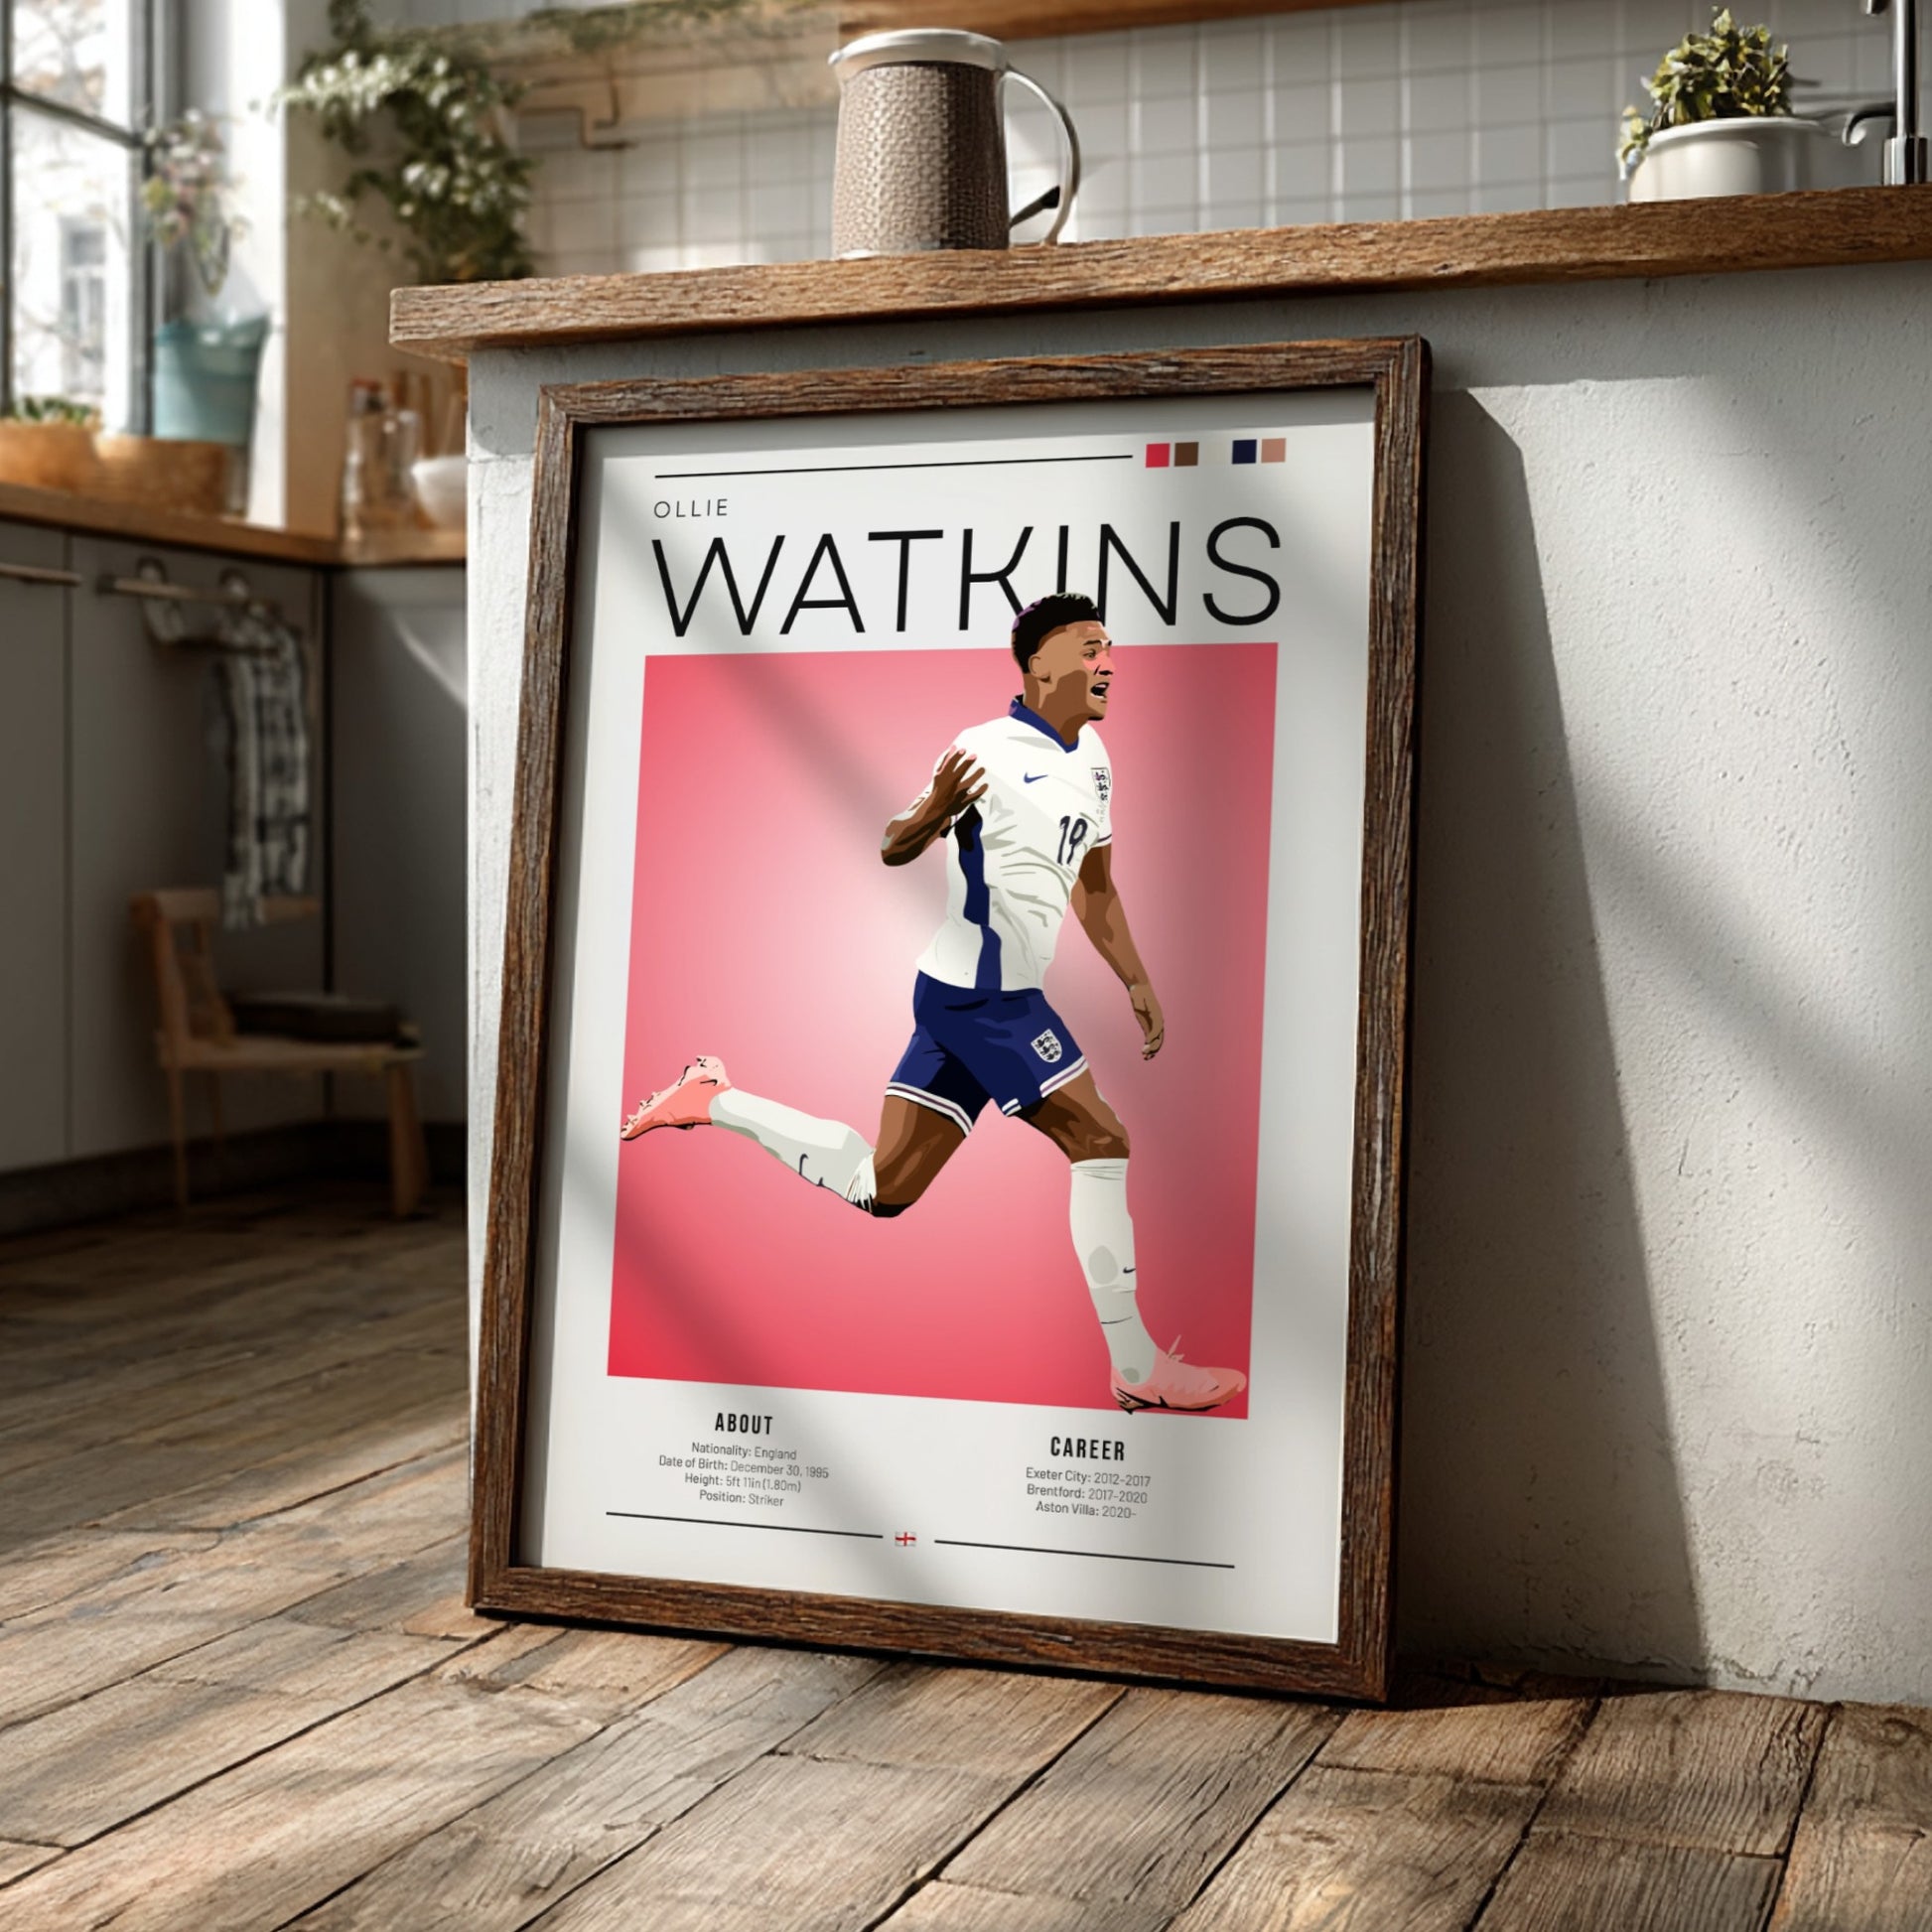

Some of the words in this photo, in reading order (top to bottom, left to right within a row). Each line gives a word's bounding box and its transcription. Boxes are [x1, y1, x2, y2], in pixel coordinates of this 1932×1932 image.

[653, 498, 728, 519] OLLIE
[651, 516, 1282, 637] WATKINS
[1056, 815, 1088, 866] 19
[715, 1412, 773, 1436] ABOUT
[691, 1442, 752, 1457] Nationality:
[754, 1447, 797, 1461] England
[1050, 1436, 1125, 1461] CAREER
[659, 1454, 683, 1467] Date
[685, 1456, 697, 1468] of
[698, 1457, 728, 1471] Birth:
[730, 1460, 784, 1476] December
[805, 1465, 830, 1479] 1995
[1026, 1466, 1063, 1480] Exeter
[1064, 1469, 1092, 1485] City:
[1094, 1471, 1152, 1488] 2012-2017
[684, 1472, 724, 1486] Height:
[726, 1476, 741, 1488] 5ft
[699, 1489, 747, 1504] Position:
[748, 1492, 784, 1507] Striker
[1027, 1483, 1086, 1499] Brentford:
[1088, 1487, 1149, 1505] 2017-2020
[1035, 1500, 1069, 1514] Aston
[1071, 1503, 1100, 1517] Villa:
[1101, 1505, 1138, 1519] 2020-
